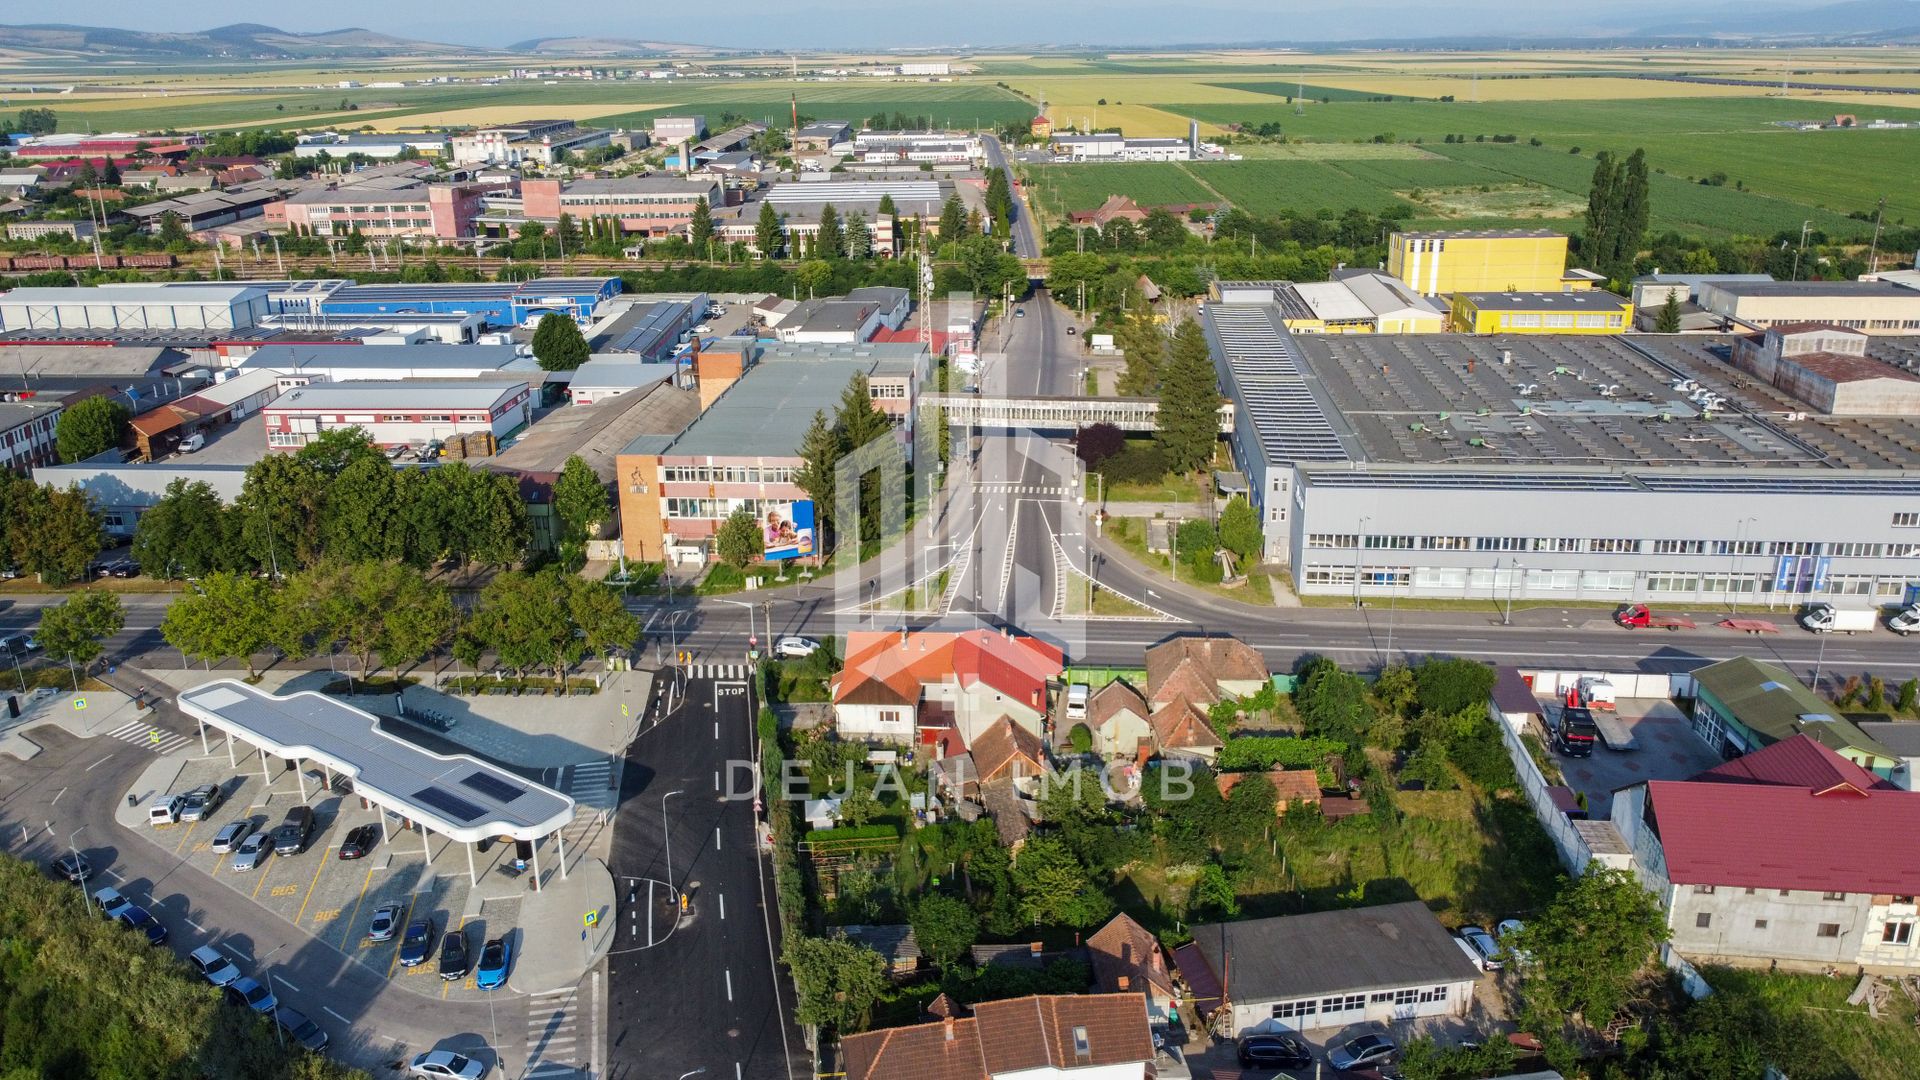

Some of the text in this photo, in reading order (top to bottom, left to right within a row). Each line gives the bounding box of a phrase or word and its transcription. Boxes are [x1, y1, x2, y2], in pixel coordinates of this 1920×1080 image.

[718, 688, 745, 696] STOP
[271, 885, 297, 896] BUS
[313, 909, 341, 921] BUS
[407, 961, 436, 976] BUS
